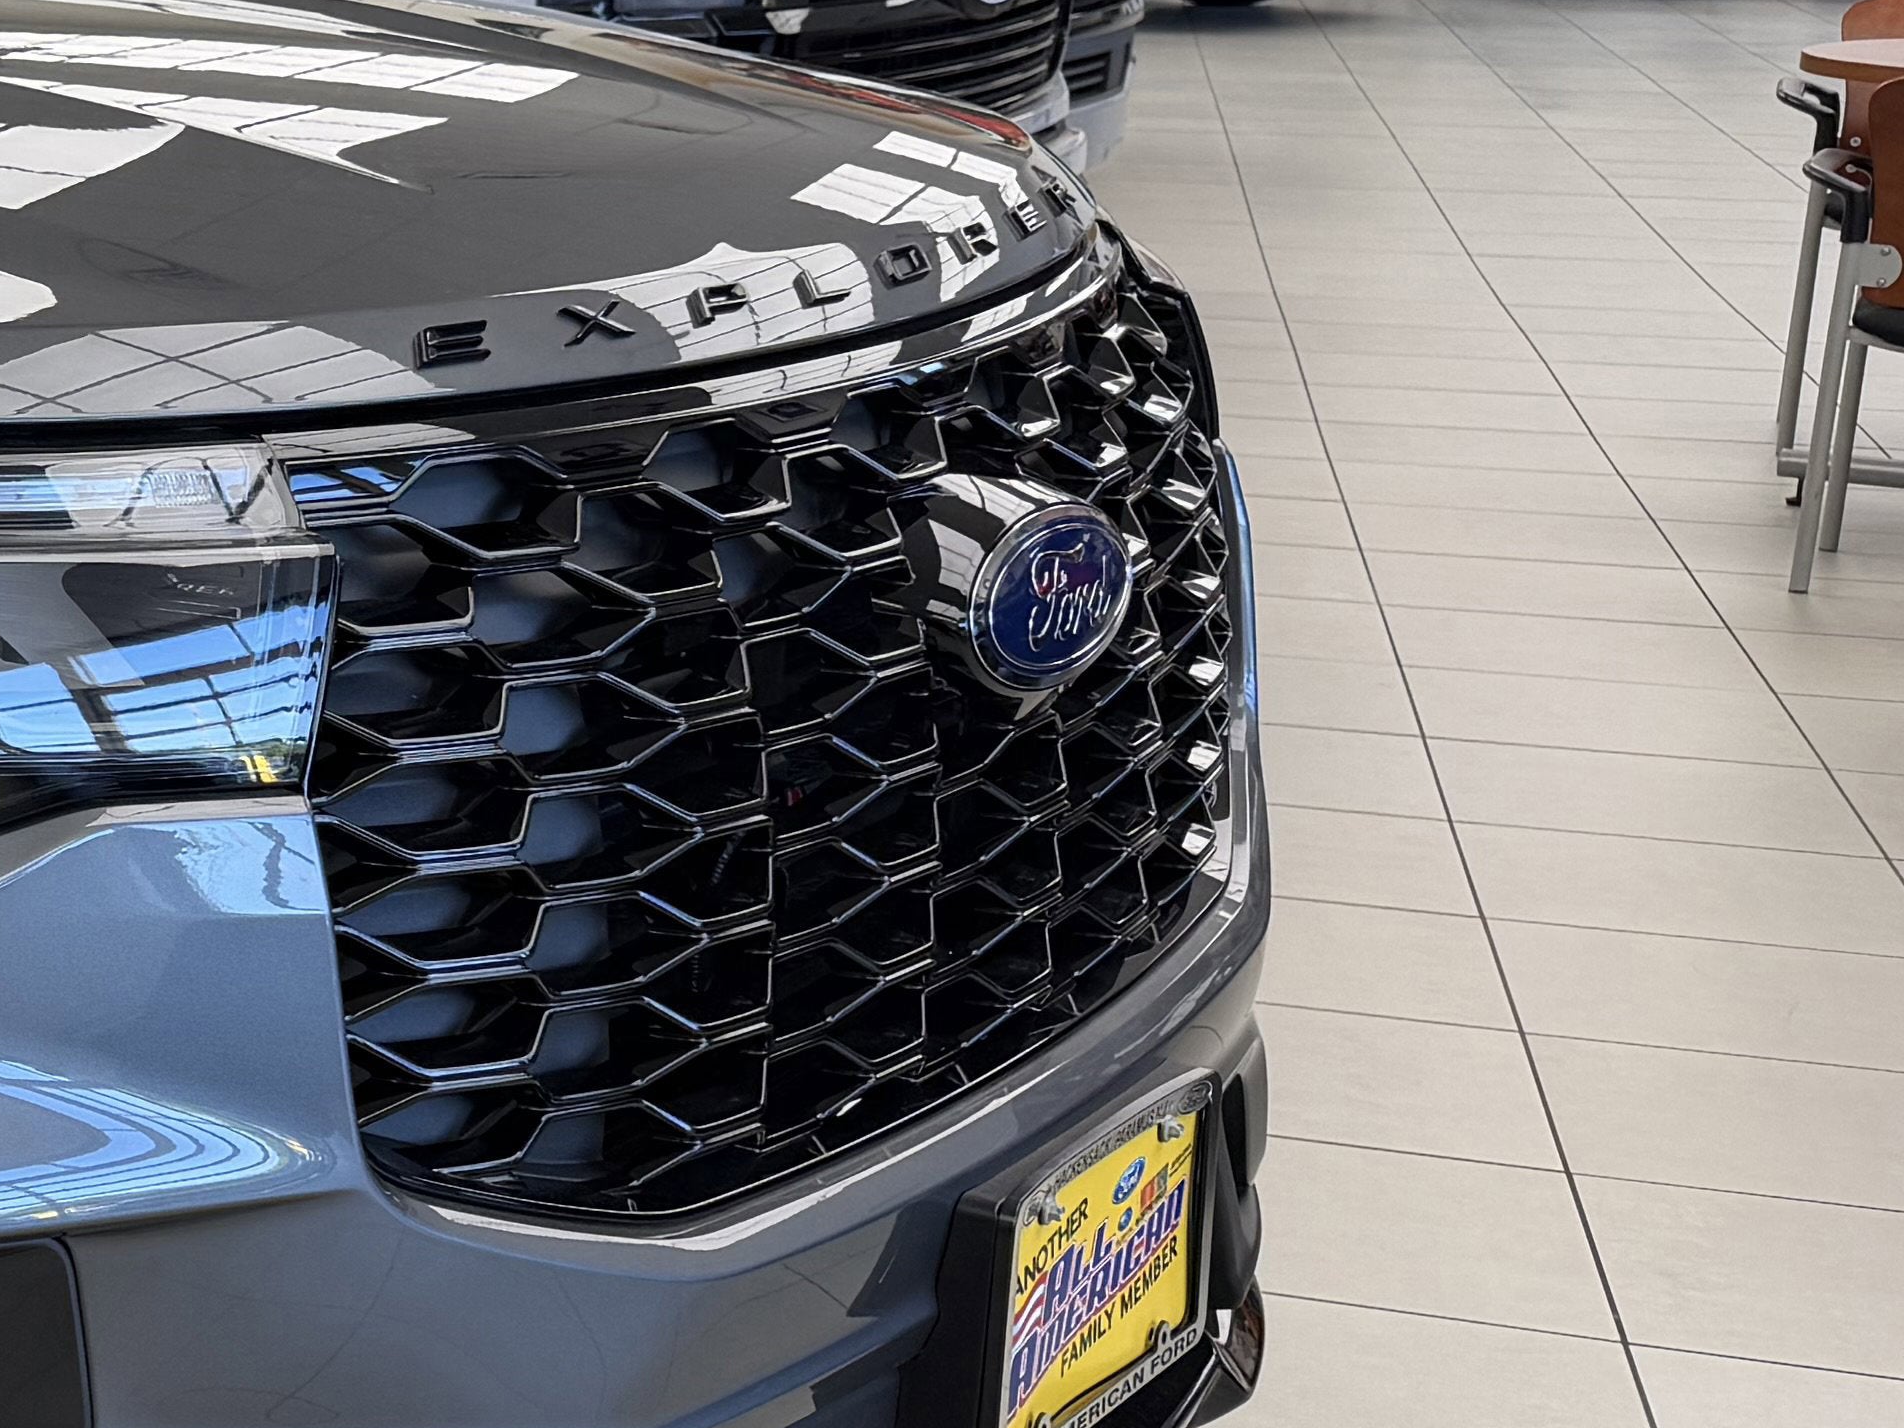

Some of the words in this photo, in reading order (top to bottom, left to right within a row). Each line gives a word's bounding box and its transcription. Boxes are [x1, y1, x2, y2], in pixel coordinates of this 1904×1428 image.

[412, 165, 1077, 370] EXPLORER
[1028, 532, 1113, 653] Ford
[1008, 1177, 1187, 1422] AMERICAN
[1014, 1196, 1090, 1298] ANOTHER
[1042, 1217, 1117, 1327] ALL
[1060, 1302, 1117, 1378] FAMILY
[1120, 1234, 1179, 1320] MEMBER
[1150, 1327, 1198, 1375] FORD
